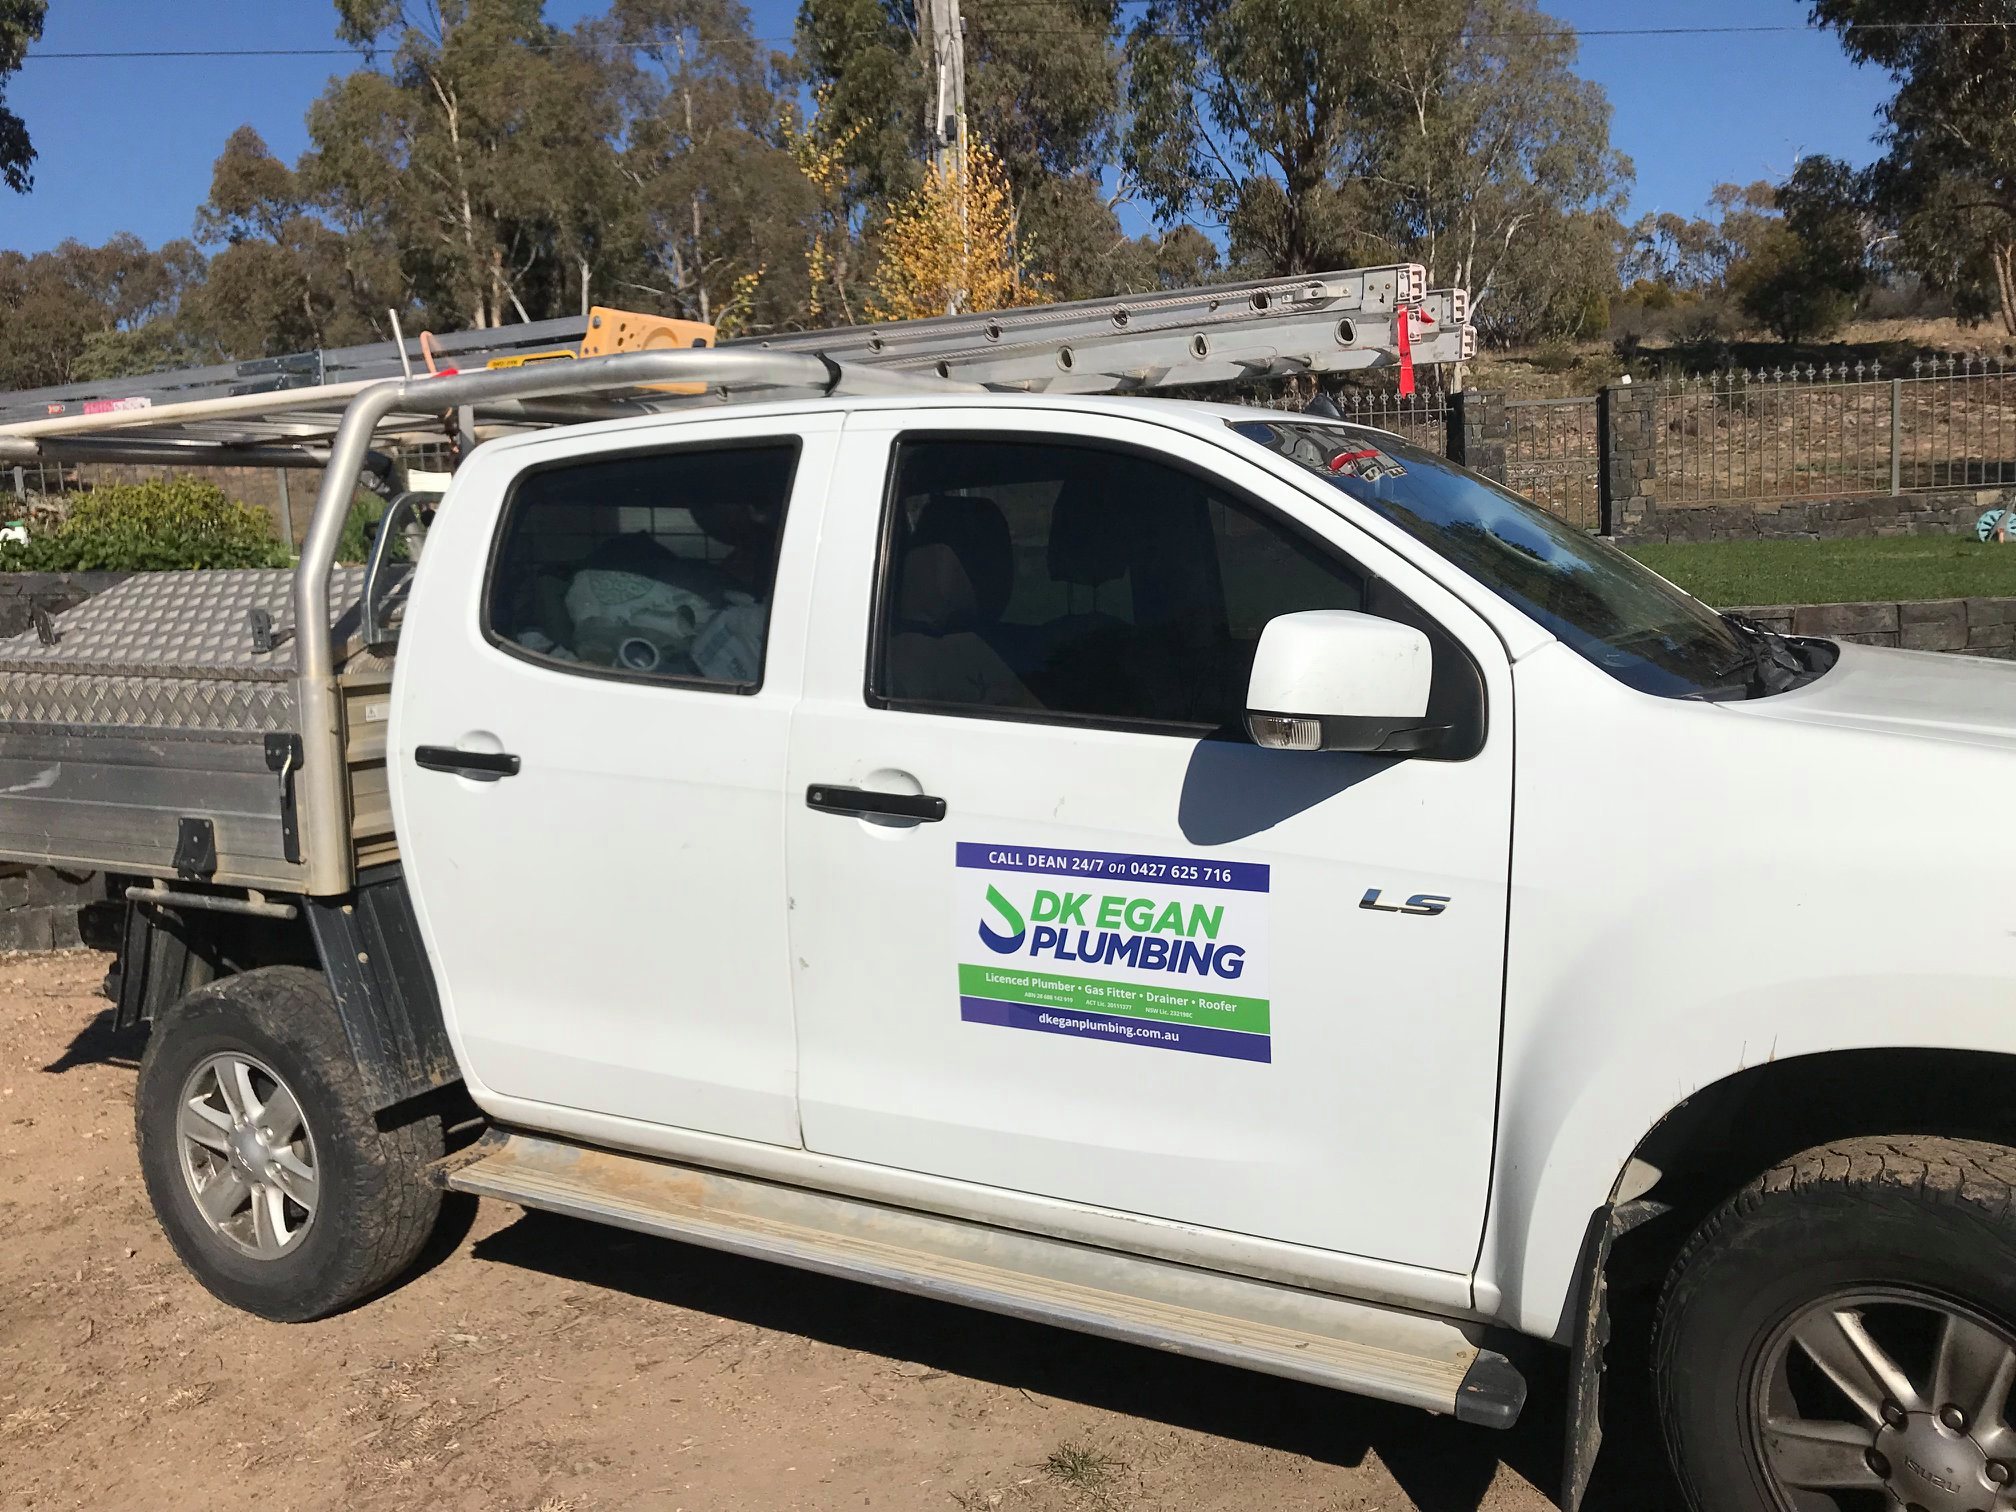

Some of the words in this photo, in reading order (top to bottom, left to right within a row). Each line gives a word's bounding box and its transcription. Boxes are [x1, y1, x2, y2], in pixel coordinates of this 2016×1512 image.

[988, 851, 1023, 866] CALL
[1027, 854, 1067, 869] DEAN
[1072, 857, 1104, 872] 24/7
[1108, 862, 1126, 874] on
[1130, 862, 1167, 877] 0427
[1171, 865, 1199, 880] 625
[1203, 868, 1232, 882] 716
[1030, 889, 1092, 926] DK
[1096, 895, 1225, 940] EGAN
[1359, 888, 1451, 916] LS
[1029, 925, 1246, 980] PLUMBING
[985, 972, 1030, 987] Licenced
[1031, 978, 1076, 992] Plumber
[1084, 984, 1104, 996] Gas
[1106, 987, 1137, 1000] Fitter
[1146, 992, 1189, 1006] Drainer
[1199, 998, 1238, 1012] Roofer
[1038, 1013, 1180, 1042] dkeganplumbing.com.au
[1904, 1455, 1961, 1494] ISUZU
